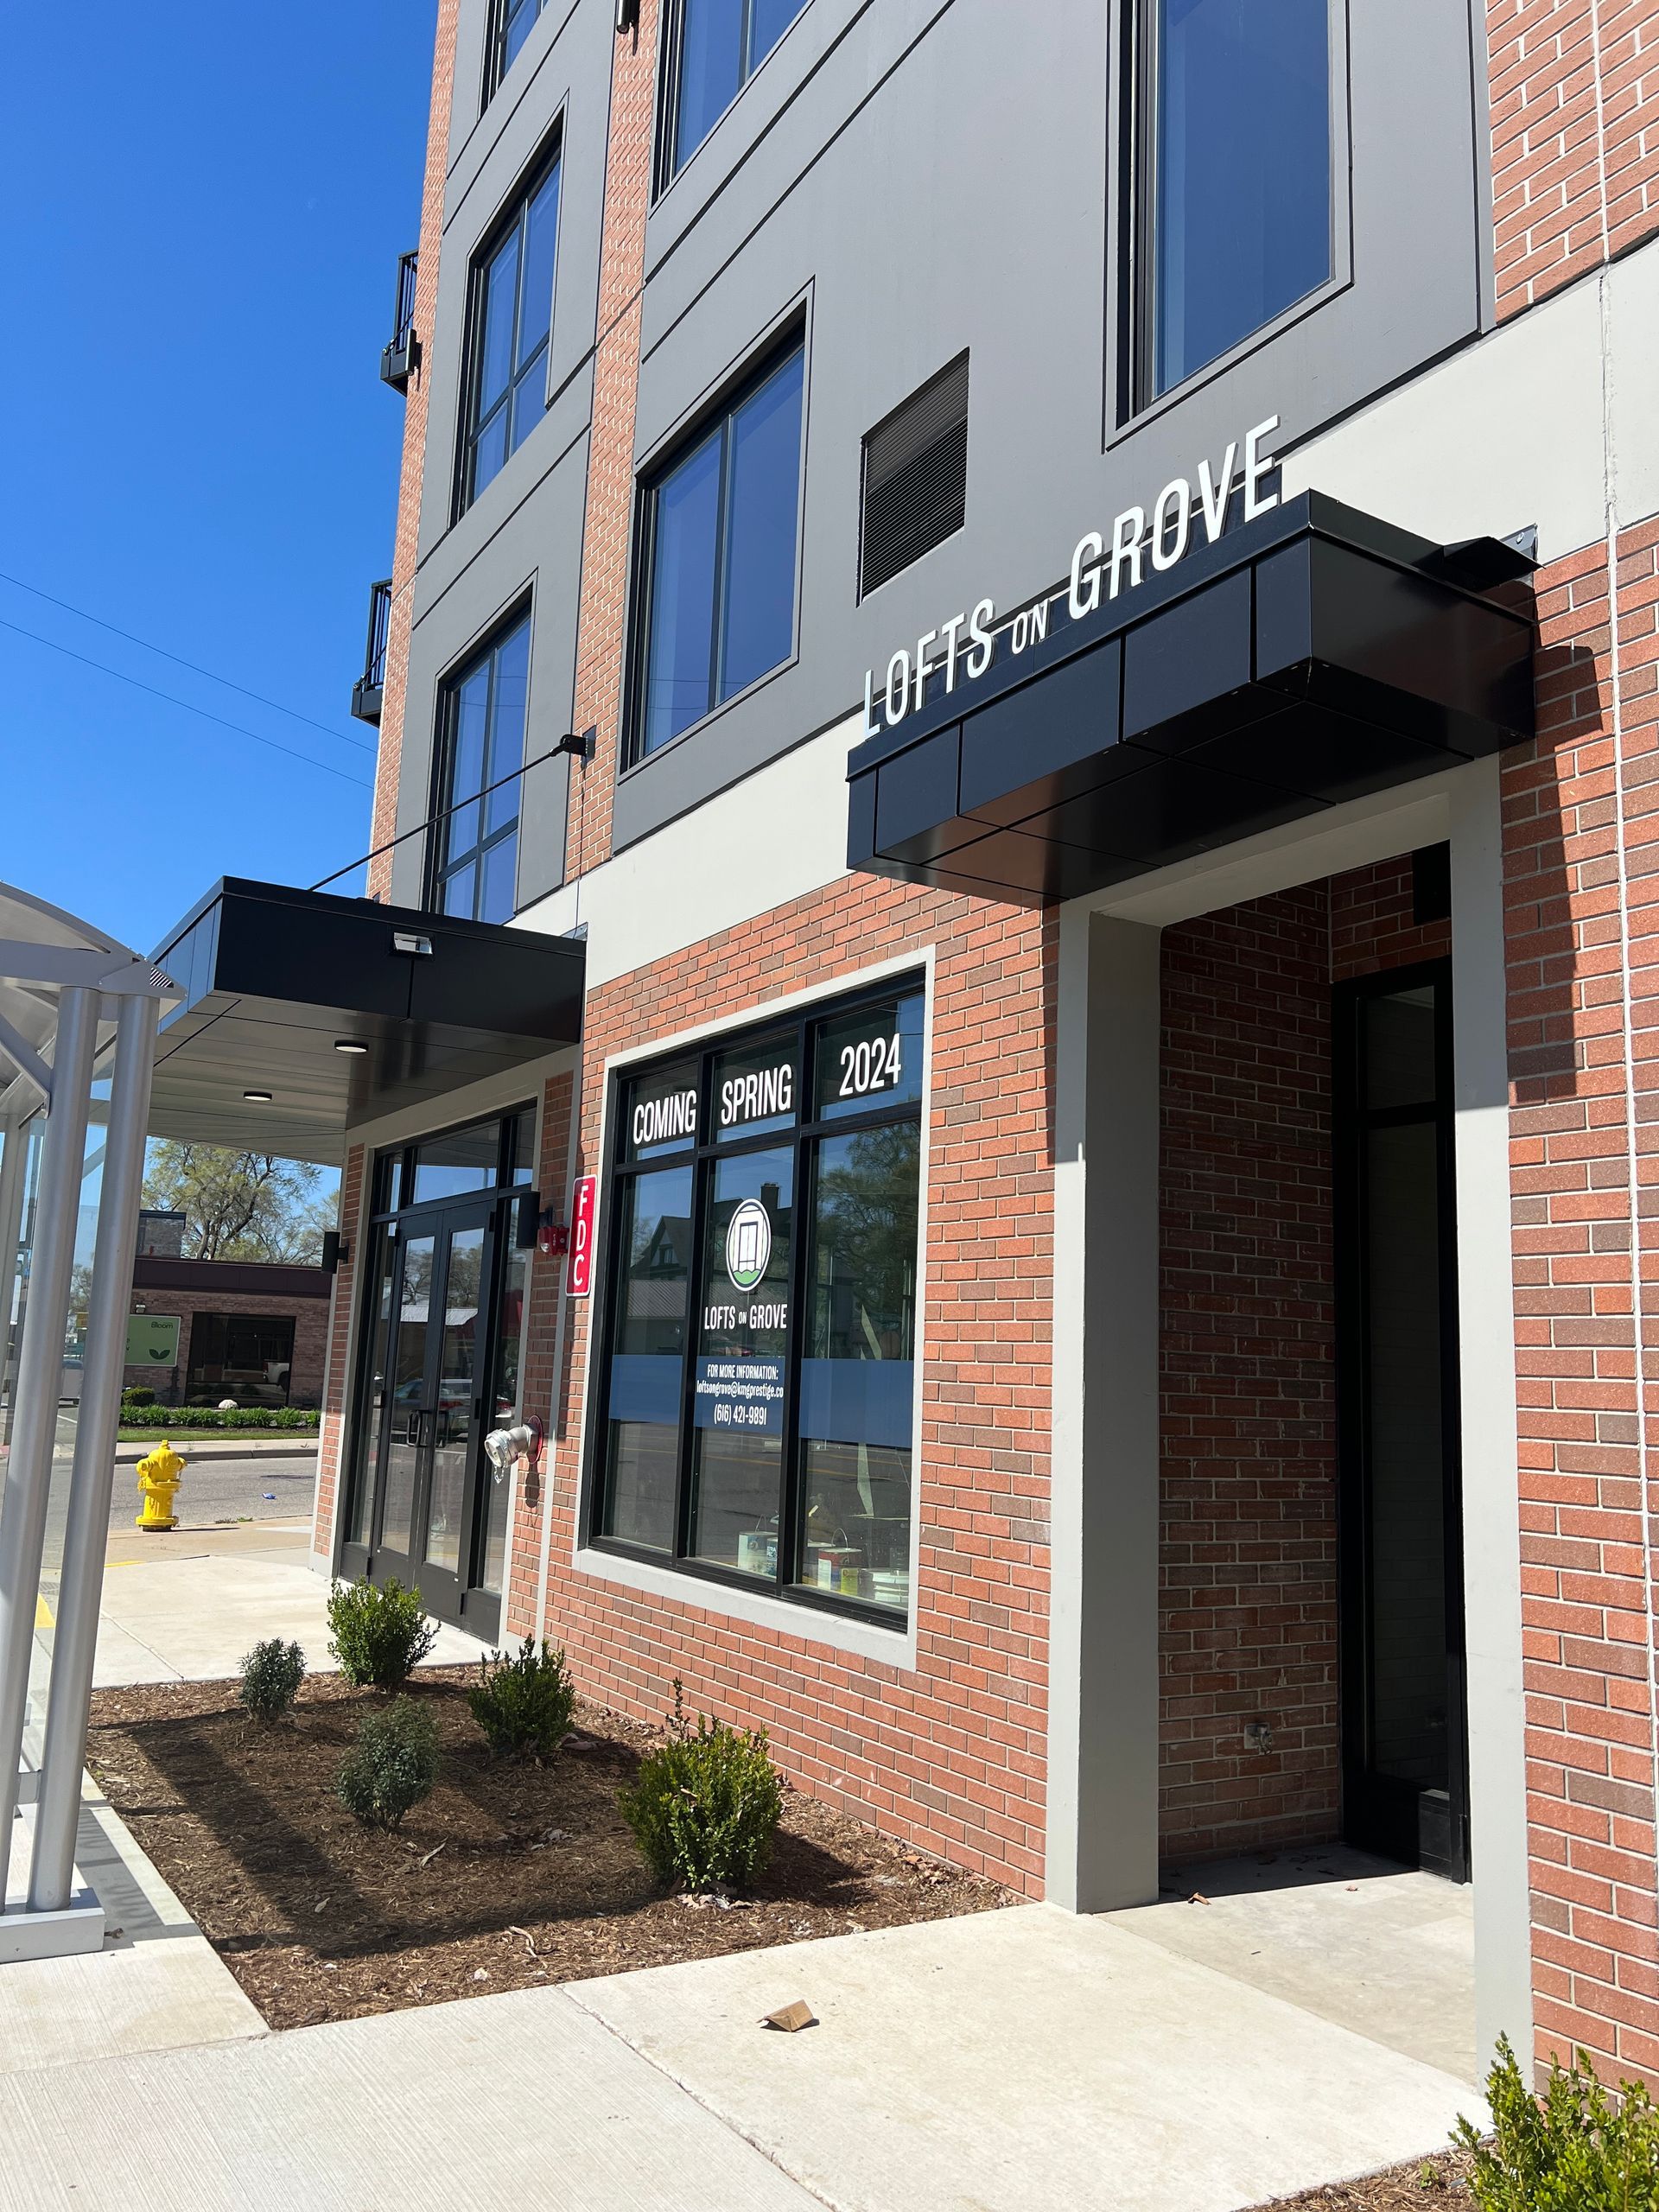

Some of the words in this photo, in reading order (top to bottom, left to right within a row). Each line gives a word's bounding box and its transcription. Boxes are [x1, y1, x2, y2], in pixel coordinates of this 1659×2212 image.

[863, 598, 995, 740] LOFTS
[1011, 598, 1051, 655] ON
[1068, 414, 1281, 620] GROVE
[633, 1089, 697, 1145] COMING
[721, 1063, 793, 1125] SPRING
[838, 1032, 902, 1096] 2024
[704, 1305, 736, 1330] LOFTS
[738, 1311, 747, 1325] ON
[749, 1303, 788, 1330] GROVE
[707, 1364, 719, 1377] FOR
[719, 1364, 736, 1379] MORE
[736, 1365, 779, 1381] INFORMATION:
[714, 1403, 732, 1426] (616)
[733, 1404, 768, 1426] 421-9891
